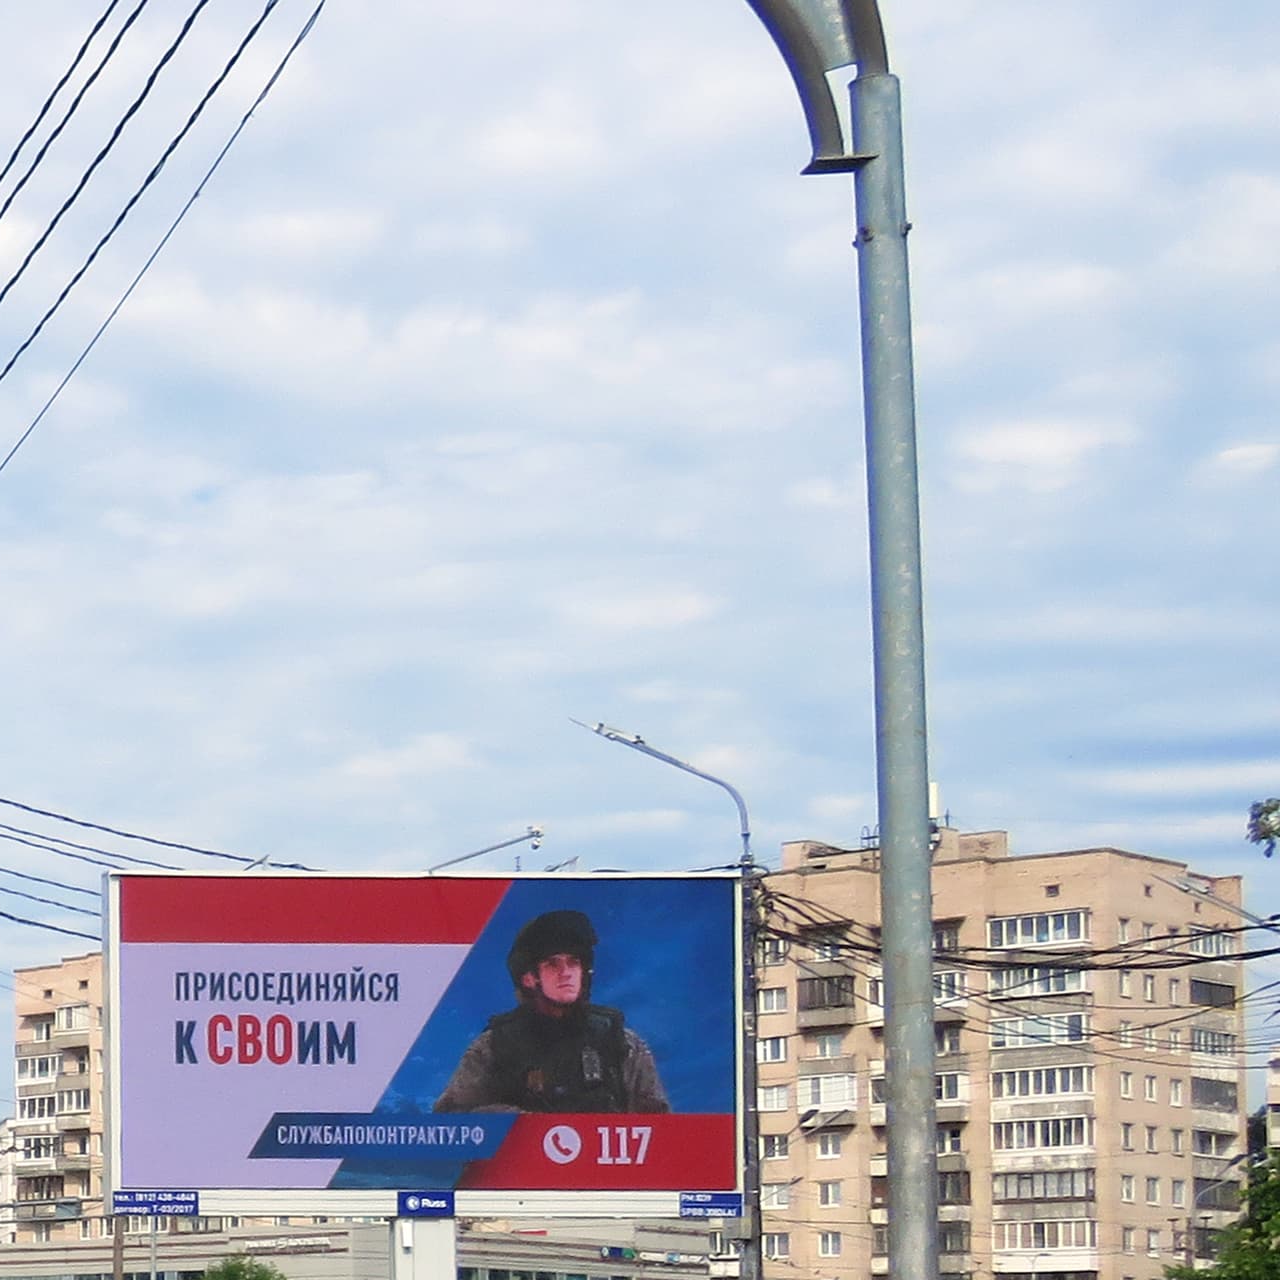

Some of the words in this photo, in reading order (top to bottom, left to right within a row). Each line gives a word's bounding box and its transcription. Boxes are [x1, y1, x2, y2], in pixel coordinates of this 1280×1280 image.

[175, 966, 399, 1005] ПРИСОЕДИНЯЙСЯ
[175, 1020, 198, 1064] К
[207, 1013, 356, 1065] СВОИМ
[277, 1125, 484, 1146] СЛУЖБАПОКОНТРАКТУ.РФ
[596, 1126, 652, 1165] 117
[421, 1198, 447, 1209] Russ
